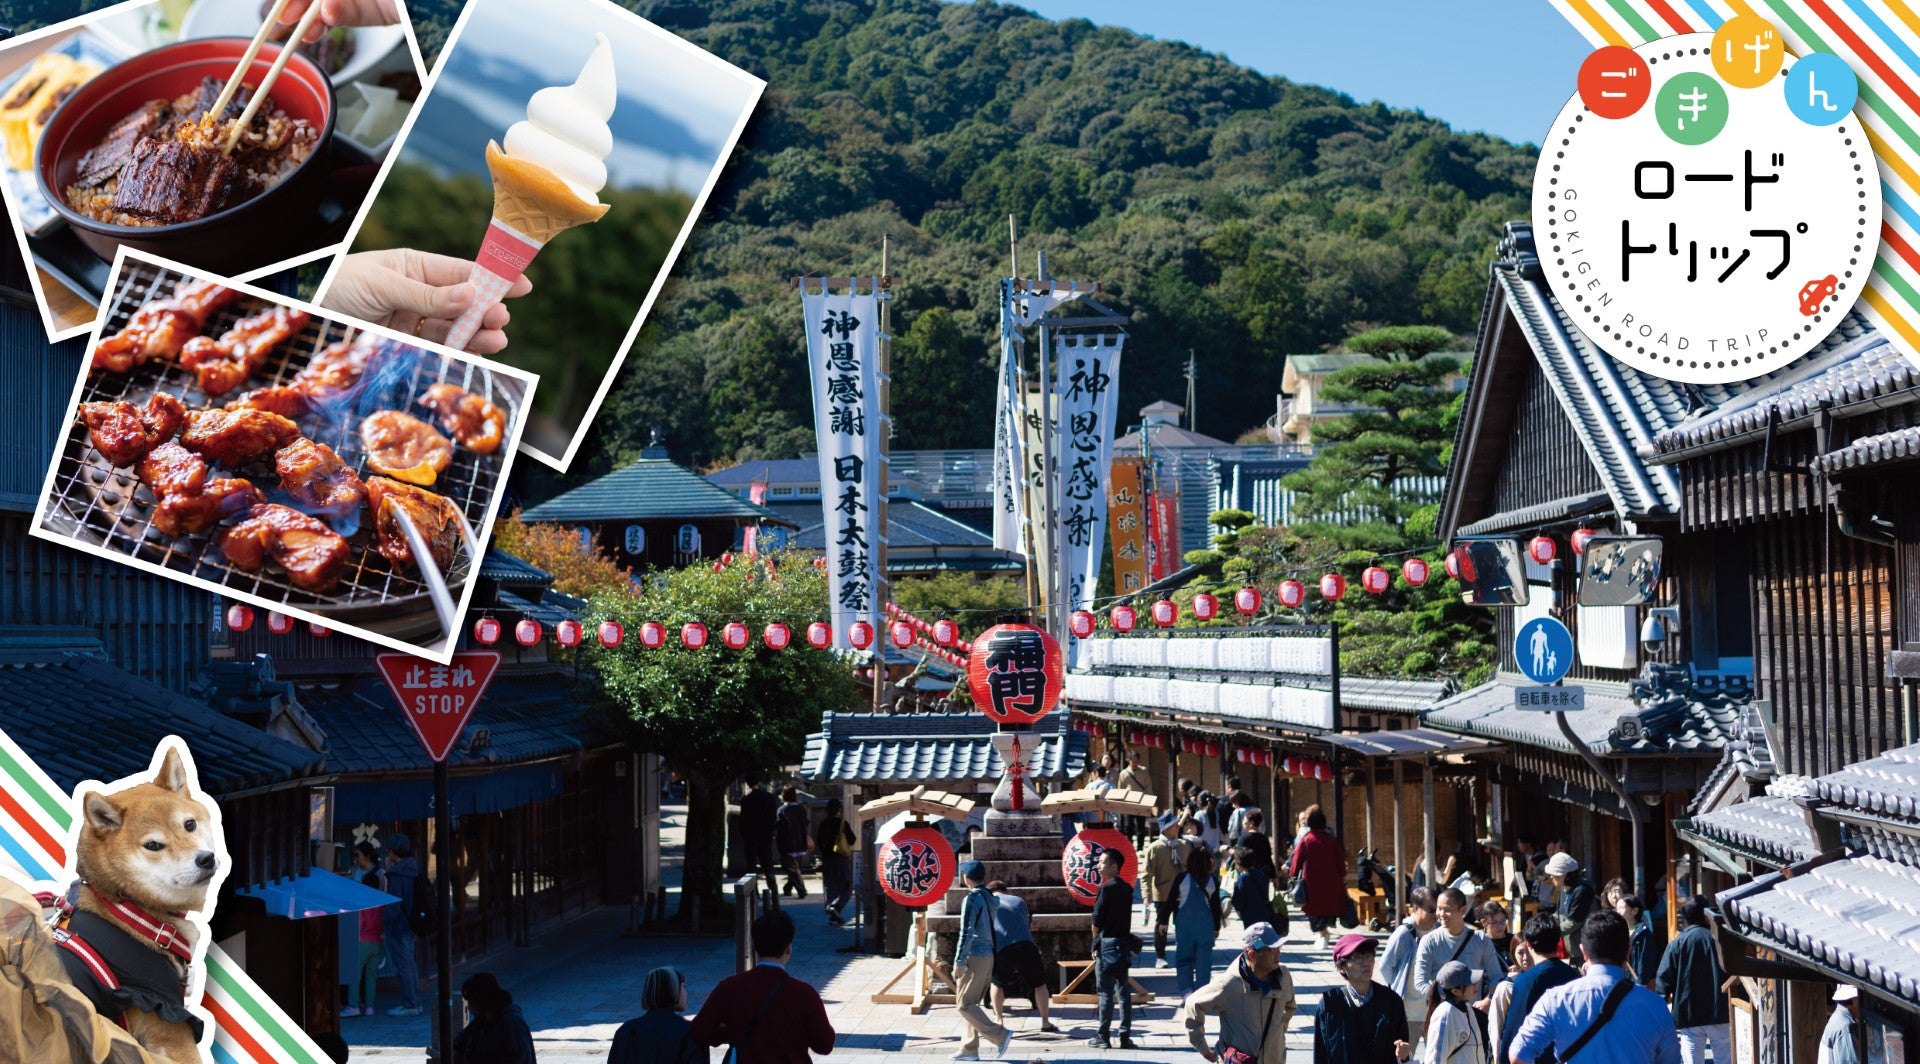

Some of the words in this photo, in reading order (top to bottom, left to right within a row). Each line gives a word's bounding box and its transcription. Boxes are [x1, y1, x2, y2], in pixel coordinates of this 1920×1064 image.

[821, 309, 865, 437] 神恩感謝
[833, 454, 870, 611] 日本太鼓祭
[402, 664, 476, 689] 止まれ
[985, 630, 1047, 716] 福門
[1520, 691, 1578, 706] 自転車を除く
[415, 694, 465, 714] STOP
